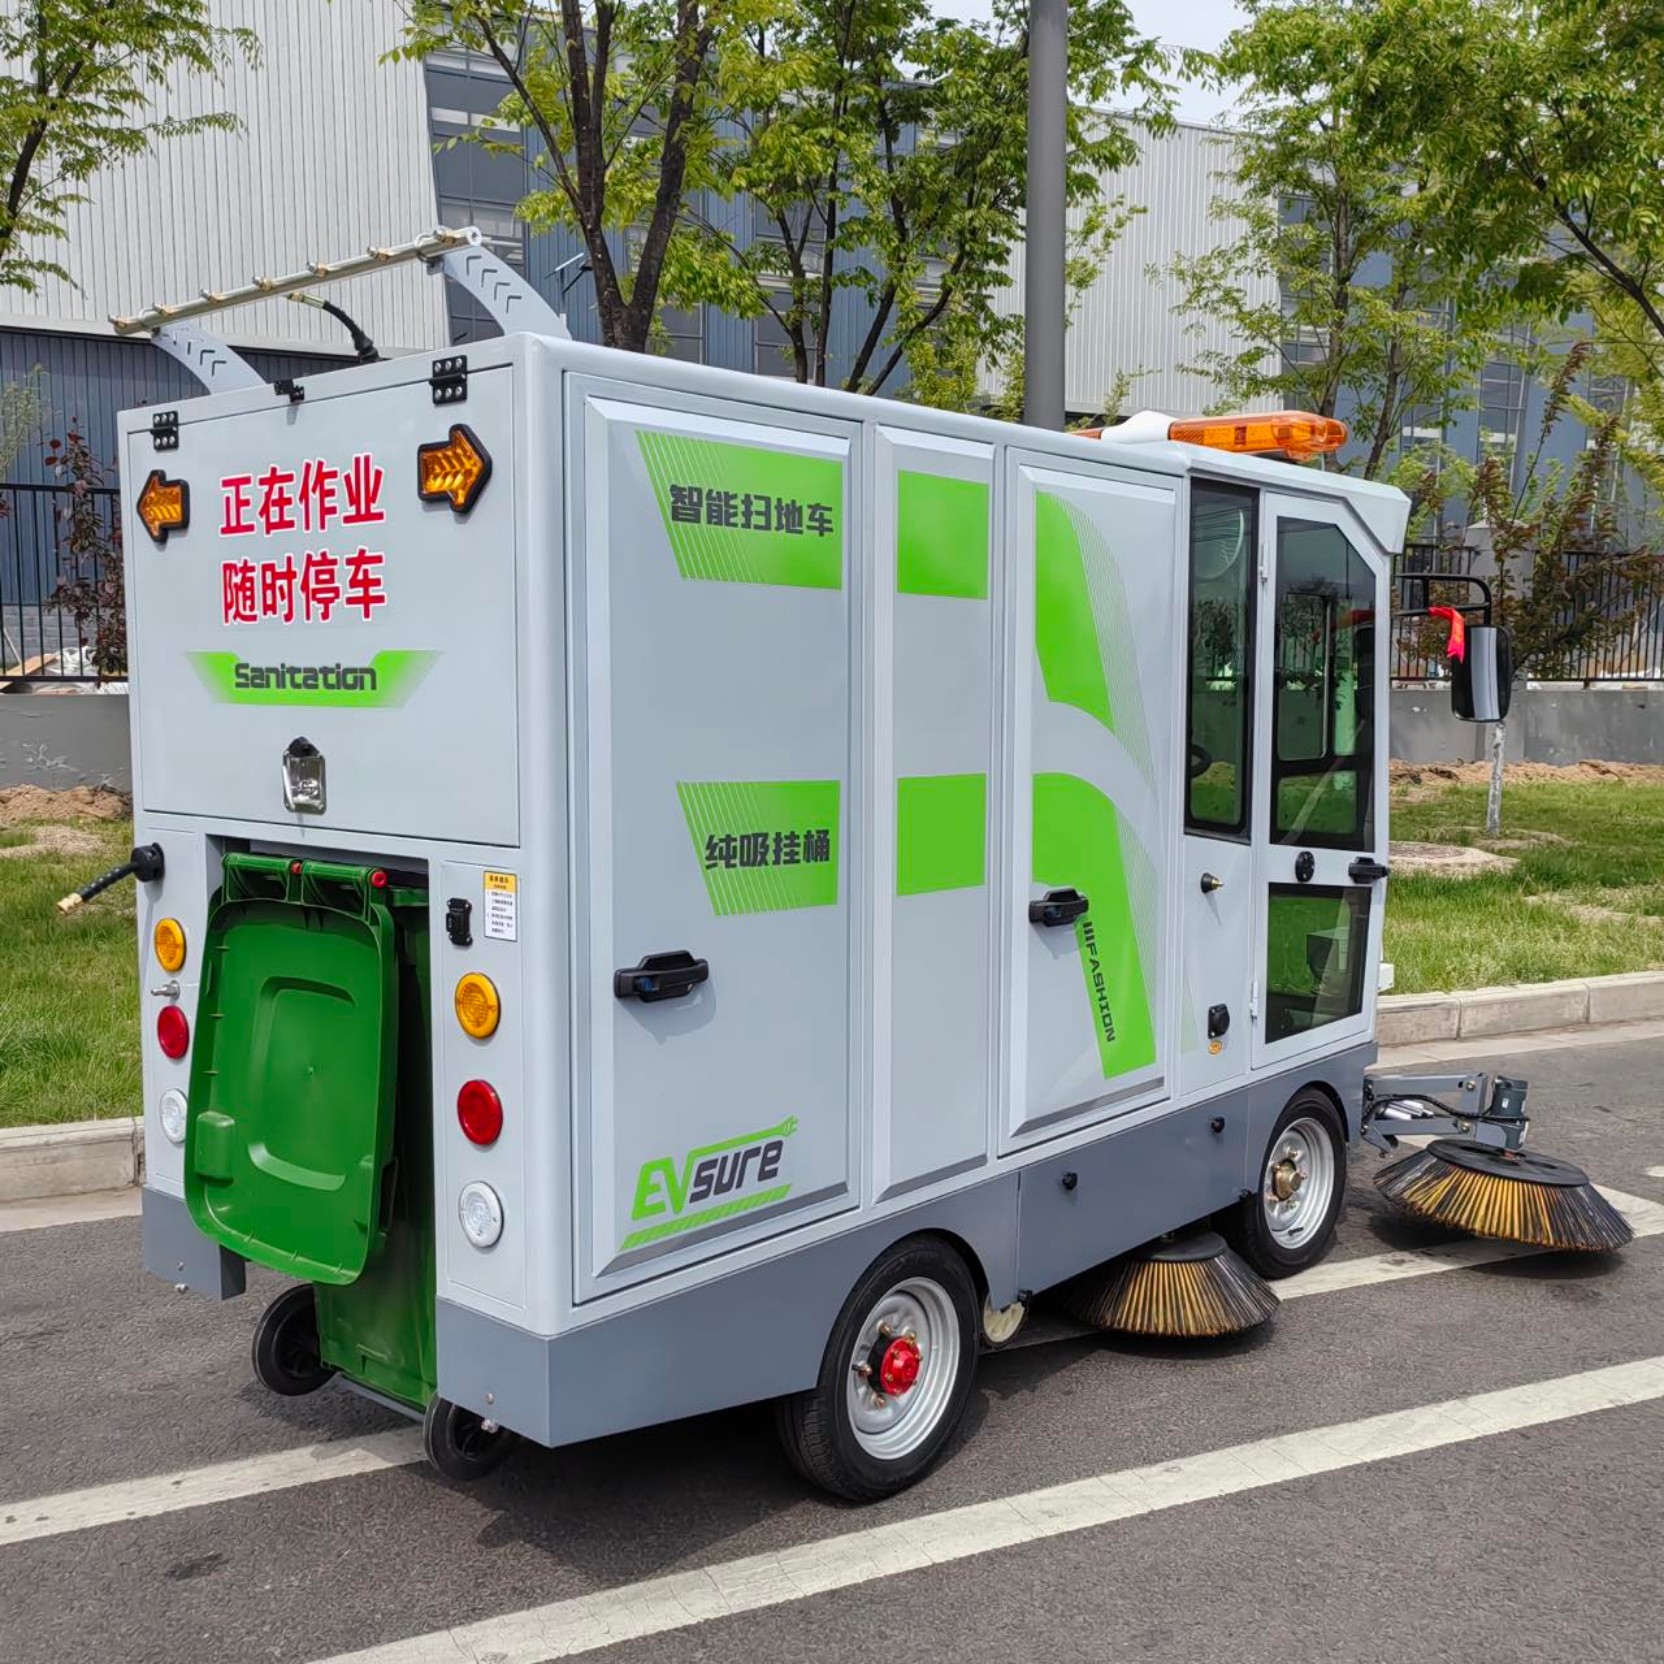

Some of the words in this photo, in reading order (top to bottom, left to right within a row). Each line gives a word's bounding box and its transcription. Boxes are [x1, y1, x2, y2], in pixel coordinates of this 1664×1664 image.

[220, 454, 385, 537] 正在作业
[669, 484, 834, 537] 智能扫地车
[222, 548, 386, 625] 随时停车
[234, 662, 378, 691] Sanitation
[705, 829, 830, 870] 纯吸挂桶
